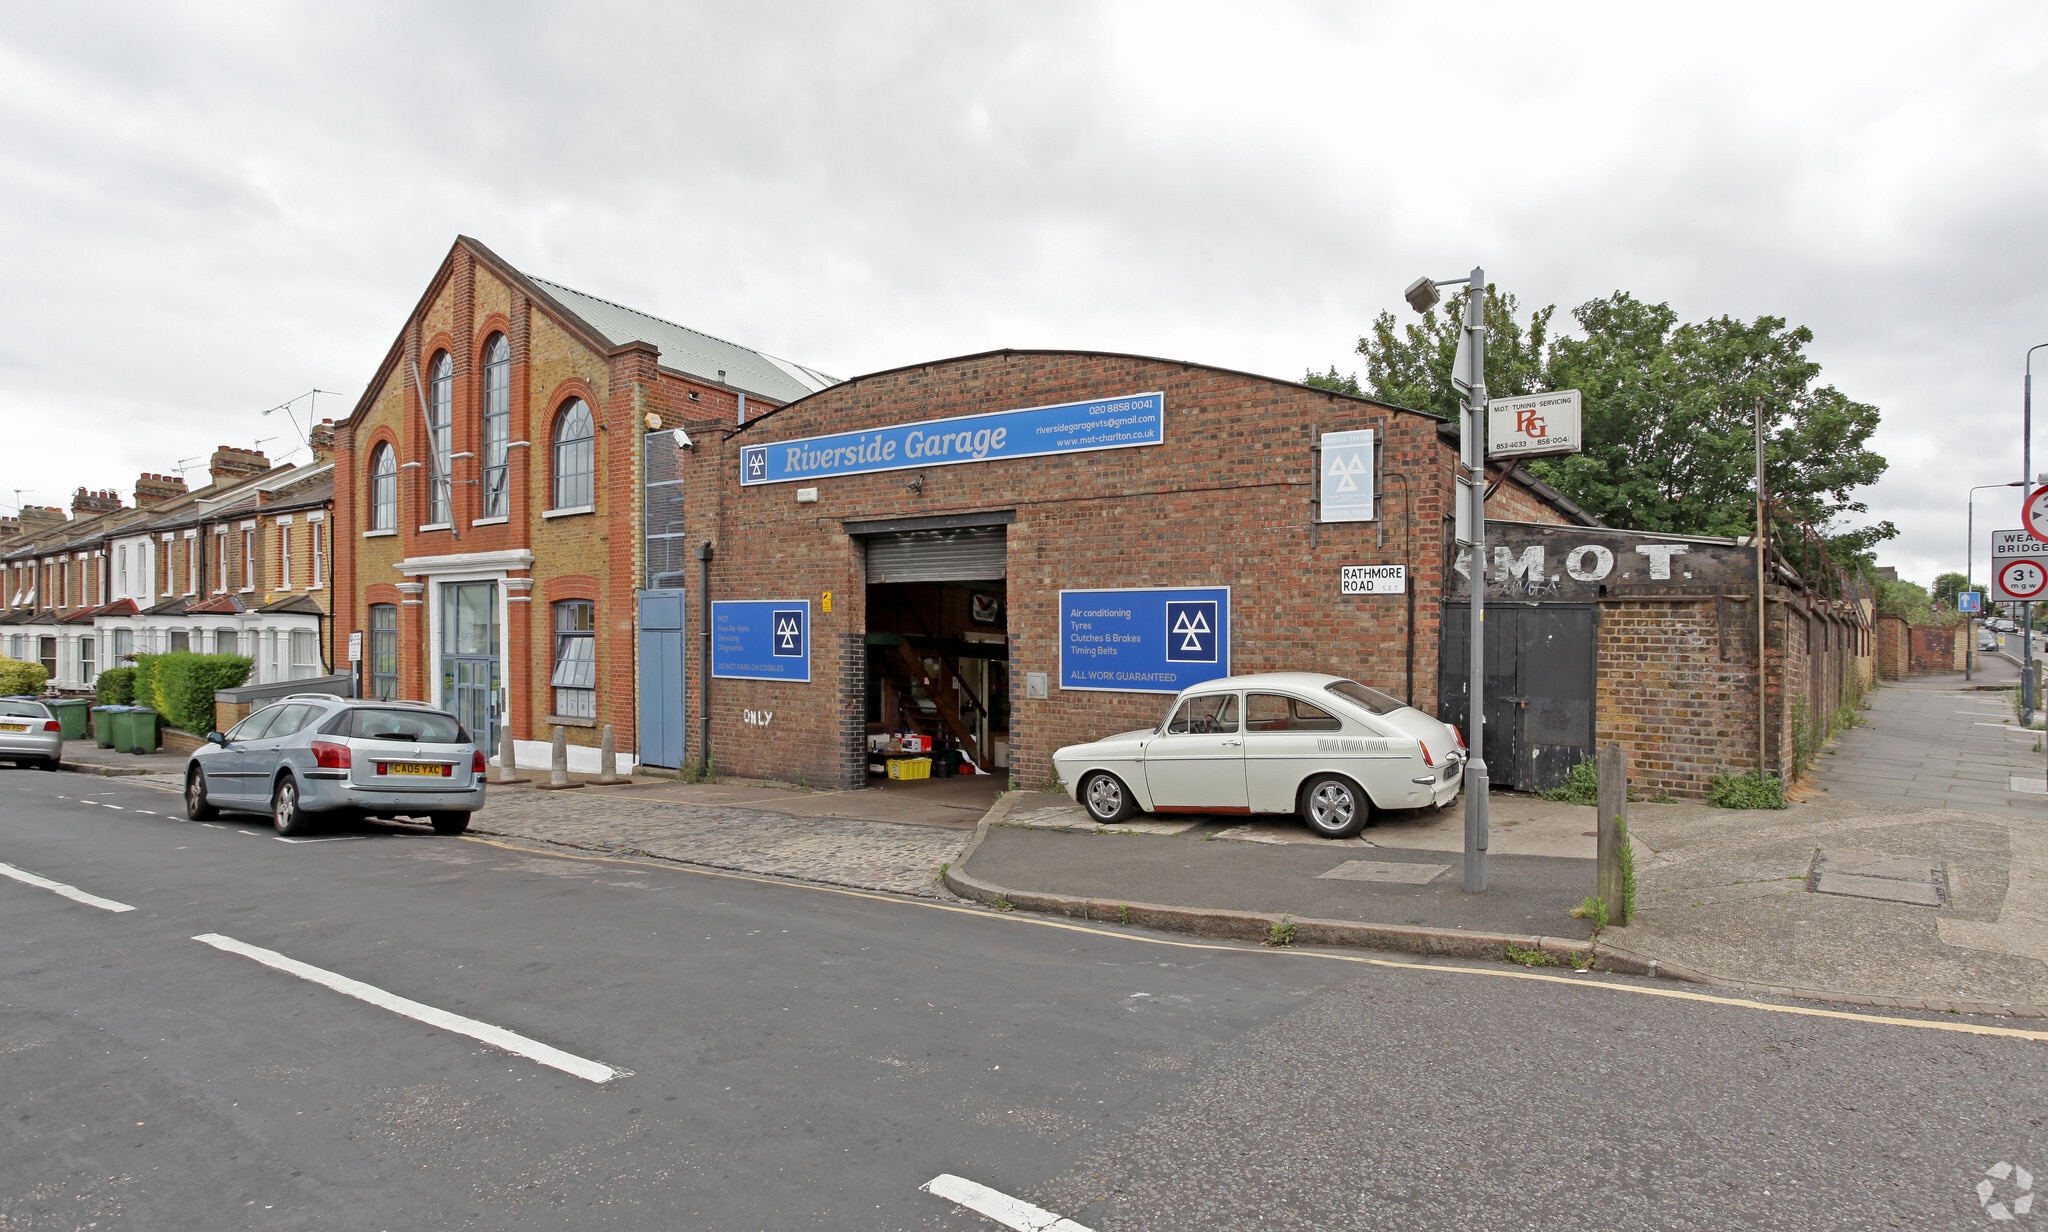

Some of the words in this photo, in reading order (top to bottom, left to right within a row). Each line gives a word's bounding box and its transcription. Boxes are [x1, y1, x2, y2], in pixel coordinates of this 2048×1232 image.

[1089, 406, 1106, 415] 020
[1107, 402, 1130, 413] 8858
[1131, 400, 1153, 410] 0041
[1512, 402, 1537, 411] TUNING
[1539, 397, 1572, 408] SERVICING
[1036, 415, 1156, 435] riversidegaragevts@gmail.com
[1056, 429, 1155, 447] www.mot-charlton.co.uk
[784, 434, 897, 473] Riverside
[904, 426, 1007, 459] Garage
[2004, 534, 2039, 542] WEA
[1998, 543, 2048, 553] BRIDGE
[1344, 567, 1402, 579] RATHMORE
[2013, 569, 2024, 581] 3
[1344, 580, 1374, 591] ROAD
[1070, 609, 1082, 617] Air
[1083, 608, 1131, 620] conditioning
[1071, 621, 1092, 631] Tyres
[1071, 633, 1104, 642] Clutches
[1105, 633, 1112, 642] &
[1113, 633, 1141, 643] Brakes
[1071, 646, 1096, 658] Timing
[1097, 646, 1118, 655] Belts
[717, 662, 726, 670] DO
[737, 663, 751, 671] PARK
[760, 664, 785, 672] COBBLES
[1071, 671, 1087, 680] ALL
[1088, 671, 1115, 680] WORK
[1116, 672, 1177, 682] GUARANTEED
[743, 708, 773, 726] ONLY
[394, 764, 420, 773] CA05
[422, 765, 440, 774] YXC
